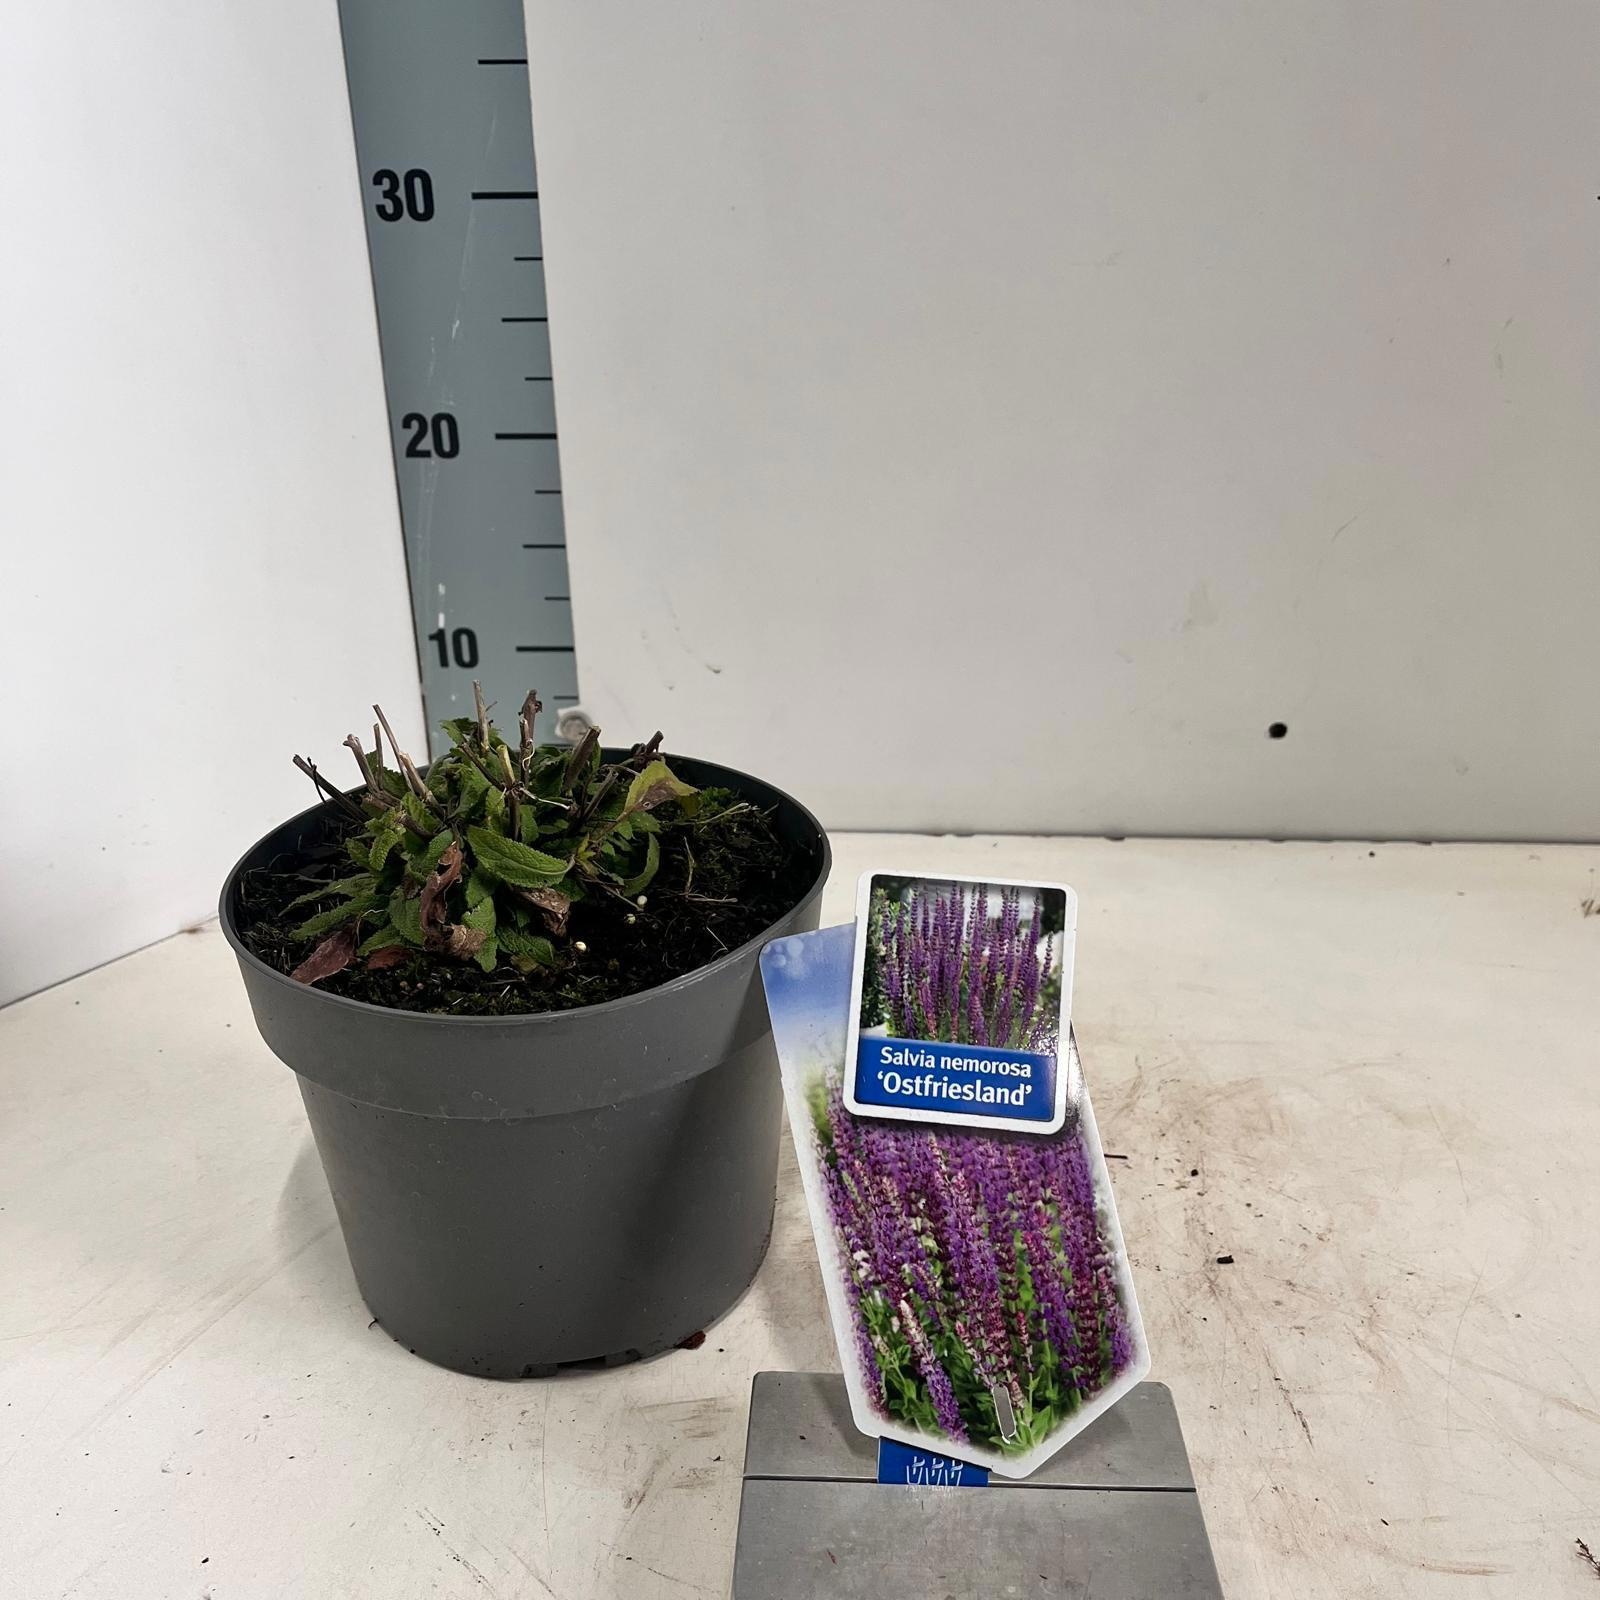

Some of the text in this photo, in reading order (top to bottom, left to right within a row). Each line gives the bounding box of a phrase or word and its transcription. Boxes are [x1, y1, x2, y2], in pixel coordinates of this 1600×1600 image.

[372, 168, 435, 223] 30
[401, 413, 460, 459] 20
[428, 628, 479, 668] 10
[880, 1046, 1032, 1078] Salvia nemorosa
